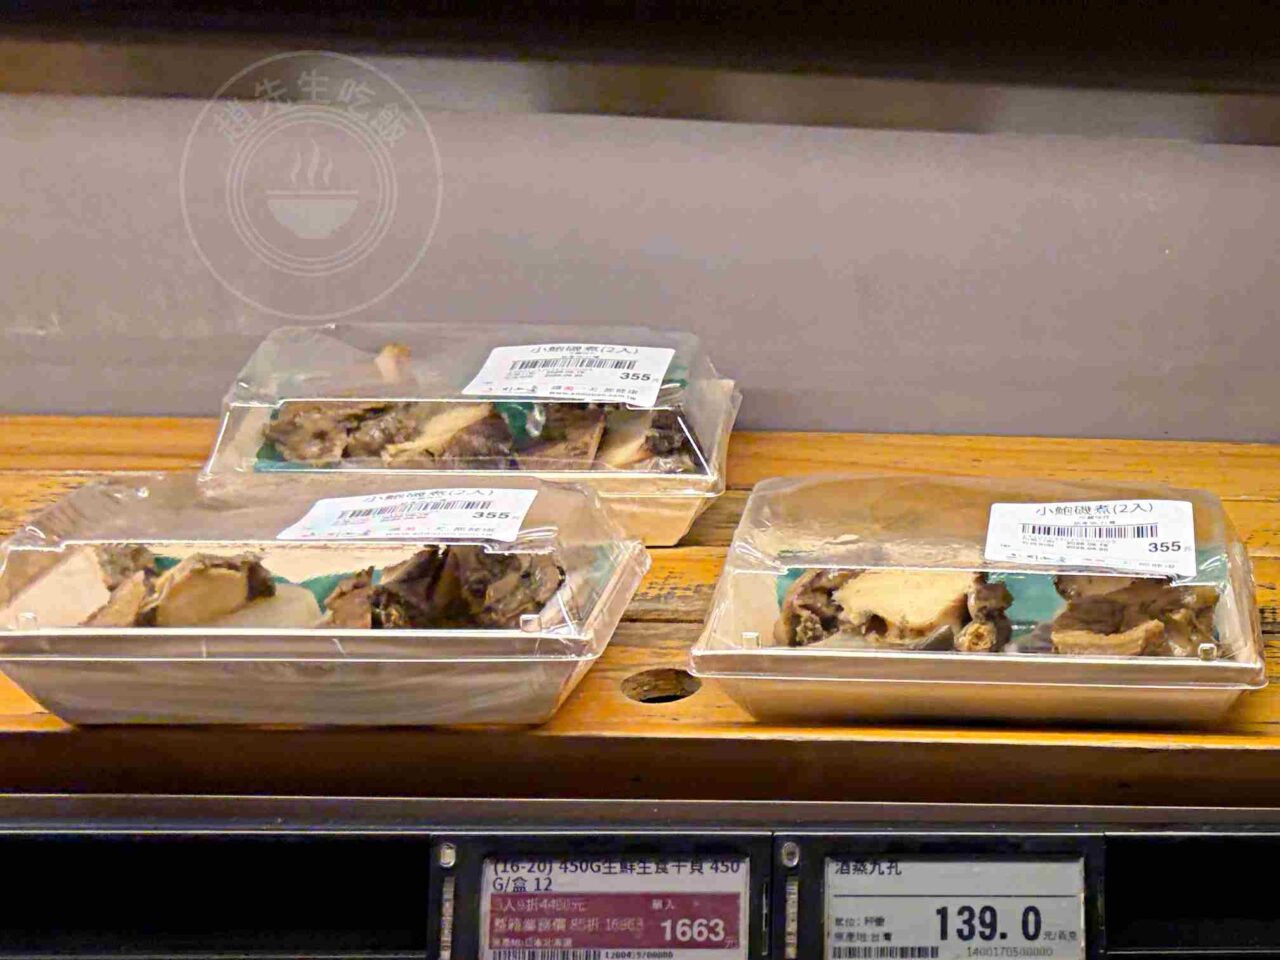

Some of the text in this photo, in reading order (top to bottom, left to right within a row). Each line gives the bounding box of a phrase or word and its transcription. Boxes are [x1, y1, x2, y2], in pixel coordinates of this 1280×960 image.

[619, 372, 651, 381] 355
[472, 511, 509, 519] 355
[1148, 541, 1181, 553] 355
[493, 861, 553, 875] (16-20)
[710, 861, 740, 873] 450
[534, 877, 553, 891] 12
[661, 918, 725, 942] 1663
